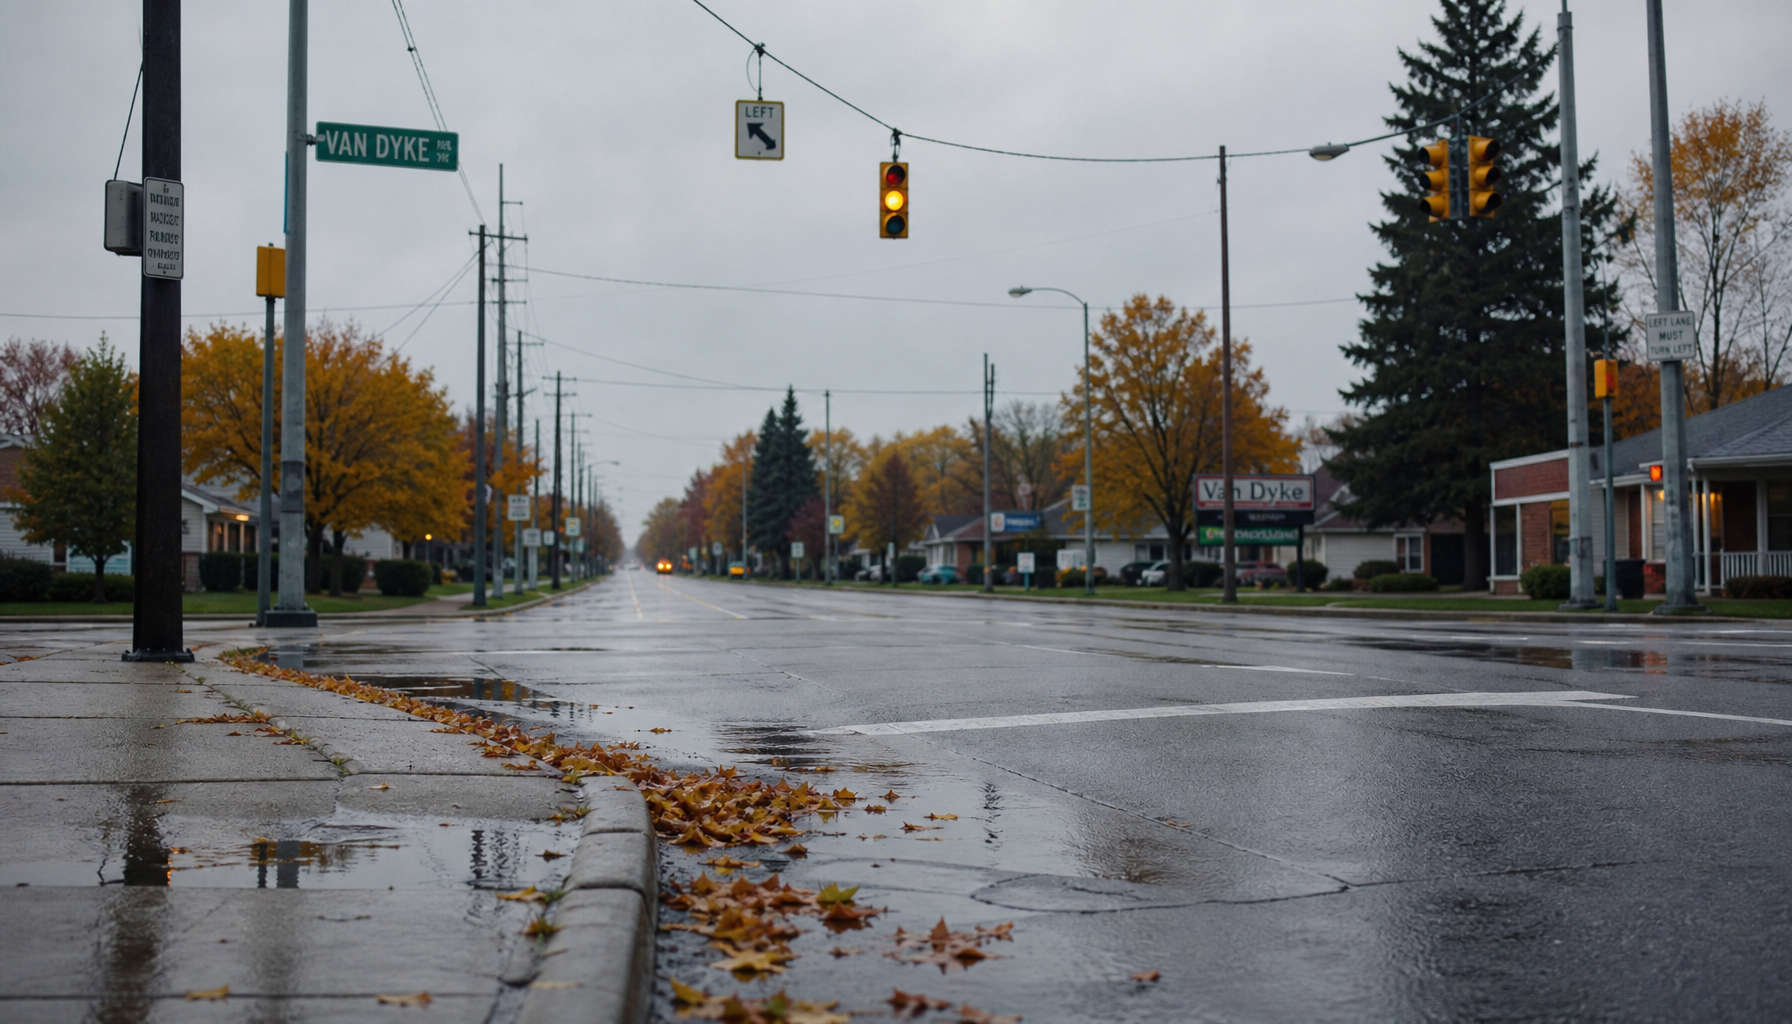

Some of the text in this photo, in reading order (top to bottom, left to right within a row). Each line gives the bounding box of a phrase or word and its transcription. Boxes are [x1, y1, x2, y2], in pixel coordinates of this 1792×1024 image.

[745, 106, 774, 118] LEFT
[326, 130, 430, 162] VAN DYKE
[1648, 316, 1691, 328] LEFT LANE
[1659, 330, 1683, 341] MUST
[1650, 346, 1670, 355] TURN
[1251, 482, 1304, 505] Dyke
